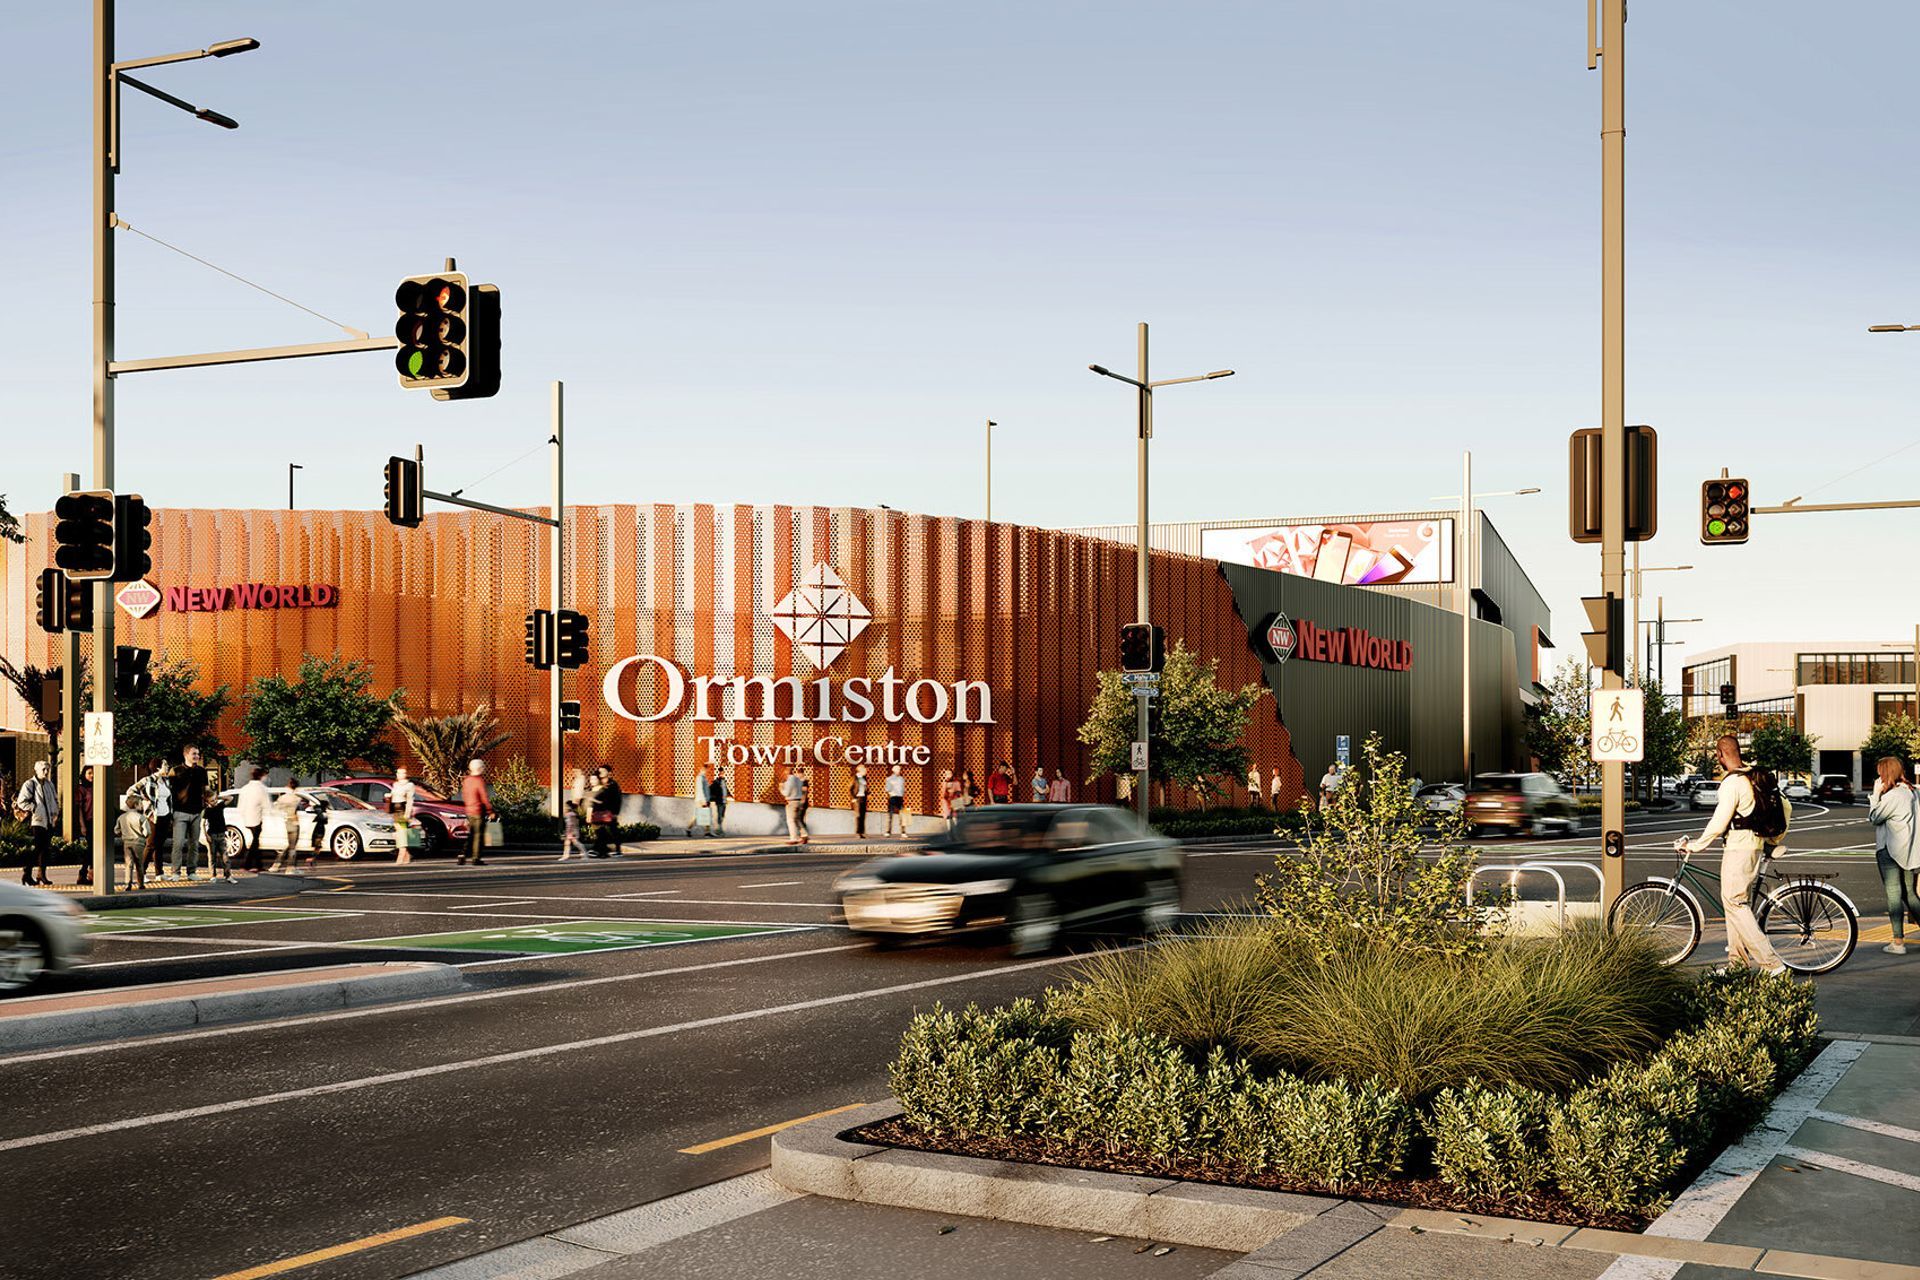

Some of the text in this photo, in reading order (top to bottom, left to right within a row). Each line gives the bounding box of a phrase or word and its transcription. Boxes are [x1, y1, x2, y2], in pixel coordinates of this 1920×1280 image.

[125, 592, 151, 604] NW
[166, 583, 334, 611] NEW WORLD
[1271, 629, 1290, 646] NW
[1297, 618, 1414, 673] NEW WORLD
[602, 653, 998, 725] Ormiston
[697, 736, 931, 767] Town Centre
